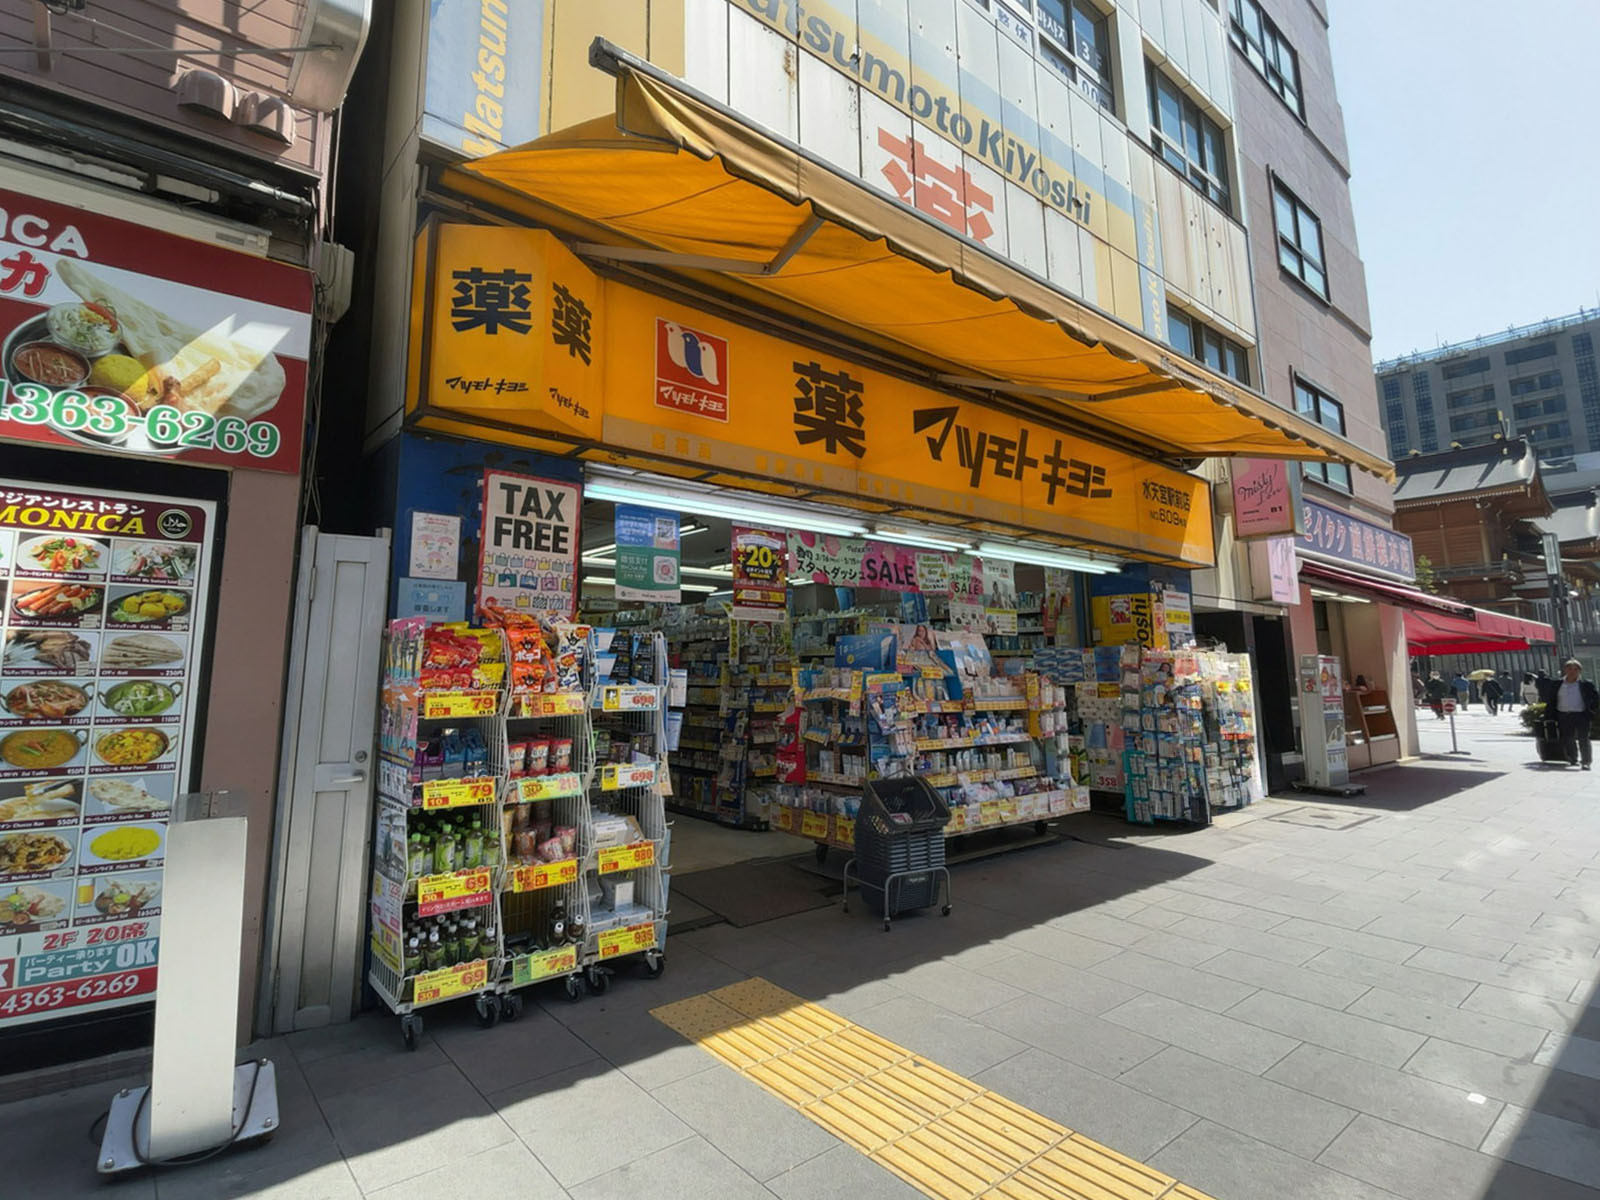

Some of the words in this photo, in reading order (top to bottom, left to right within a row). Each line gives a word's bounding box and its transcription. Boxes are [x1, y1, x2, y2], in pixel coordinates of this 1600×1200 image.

[451, 267, 533, 335] 薬
[552, 281, 592, 367] 薬
[445, 376, 529, 395] マツモトキヨシ
[658, 385, 726, 413] マツモトキヨシ
[549, 387, 590, 419] マツモトキヨシ
[793, 360, 867, 459] 薬
[913, 405, 1113, 506] マツモトキヨシ
[500, 482, 566, 522] TAX
[494, 516, 569, 554] FREE
[797, 560, 865, 581] スタートダッシュ
[866, 558, 917, 586] SALE
[954, 582, 980, 595] SALE
[1131, 597, 1151, 652] oshi
[471, 697, 494, 710] 79
[469, 785, 493, 798] 79
[465, 874, 488, 890] 69
[43, 931, 78, 951] 2F
[86, 922, 149, 945] 20席
[116, 941, 157, 968] OK
[24, 958, 110, 982] Party
[461, 969, 484, 985] 69
[1, 974, 139, 1014] 4363-6269
